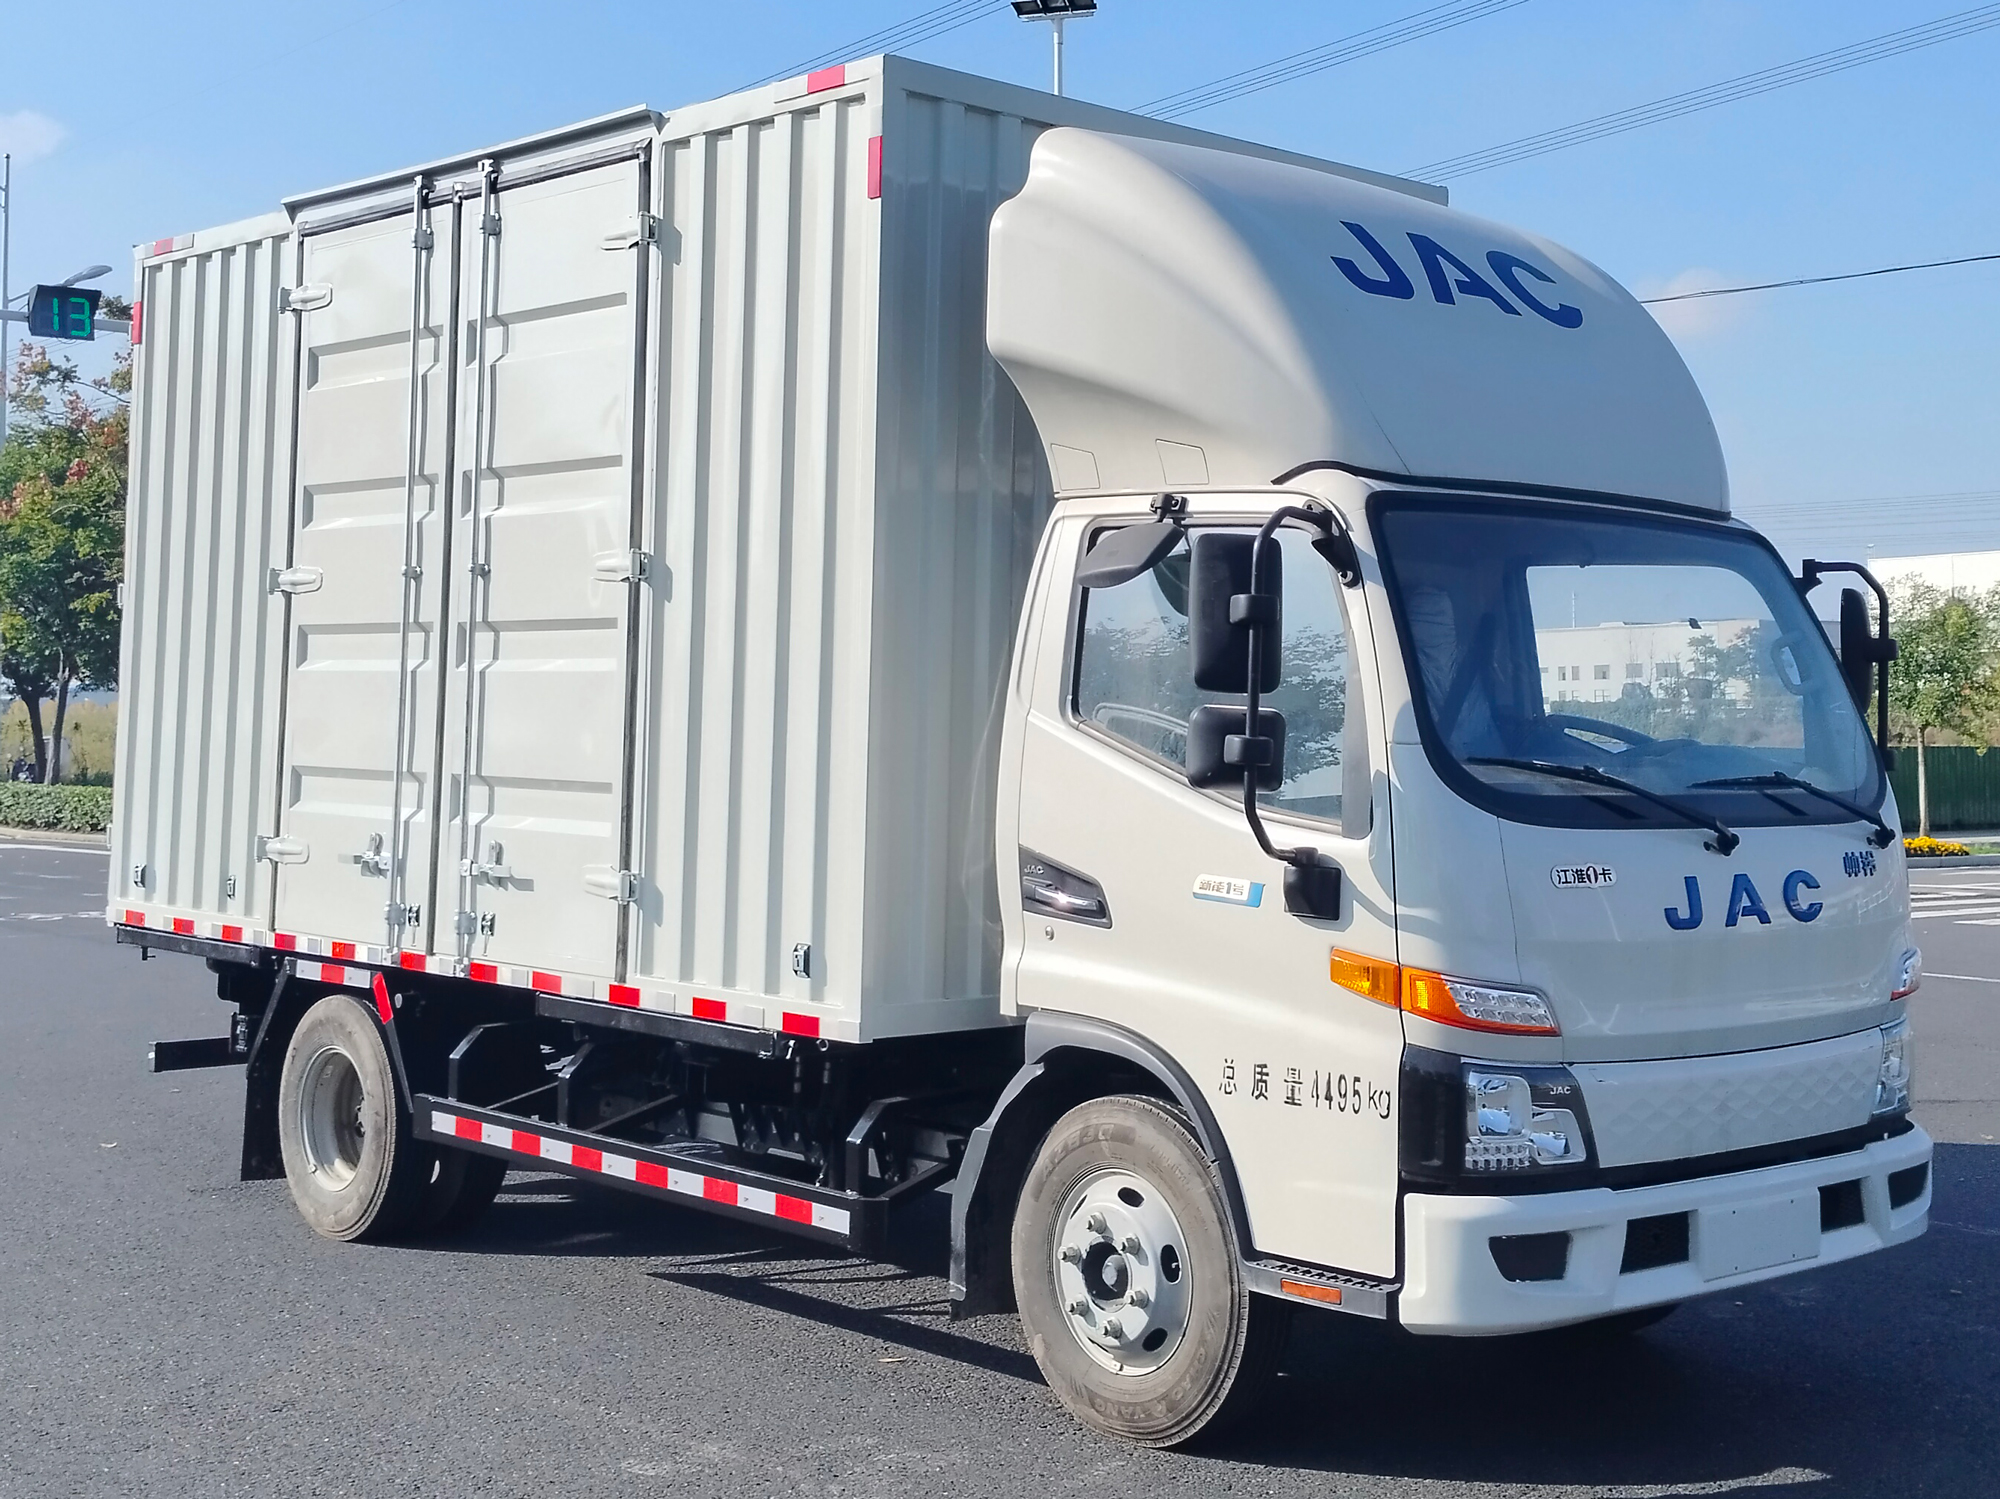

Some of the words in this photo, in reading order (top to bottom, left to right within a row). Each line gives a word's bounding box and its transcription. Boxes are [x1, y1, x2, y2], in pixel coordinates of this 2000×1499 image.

[1330, 220, 1584, 329] JAC
[53, 297, 91, 337] 13
[1024, 864, 1045, 875] JAC
[1664, 869, 1824, 931] JAC
[1550, 1086, 1571, 1095] JAC
